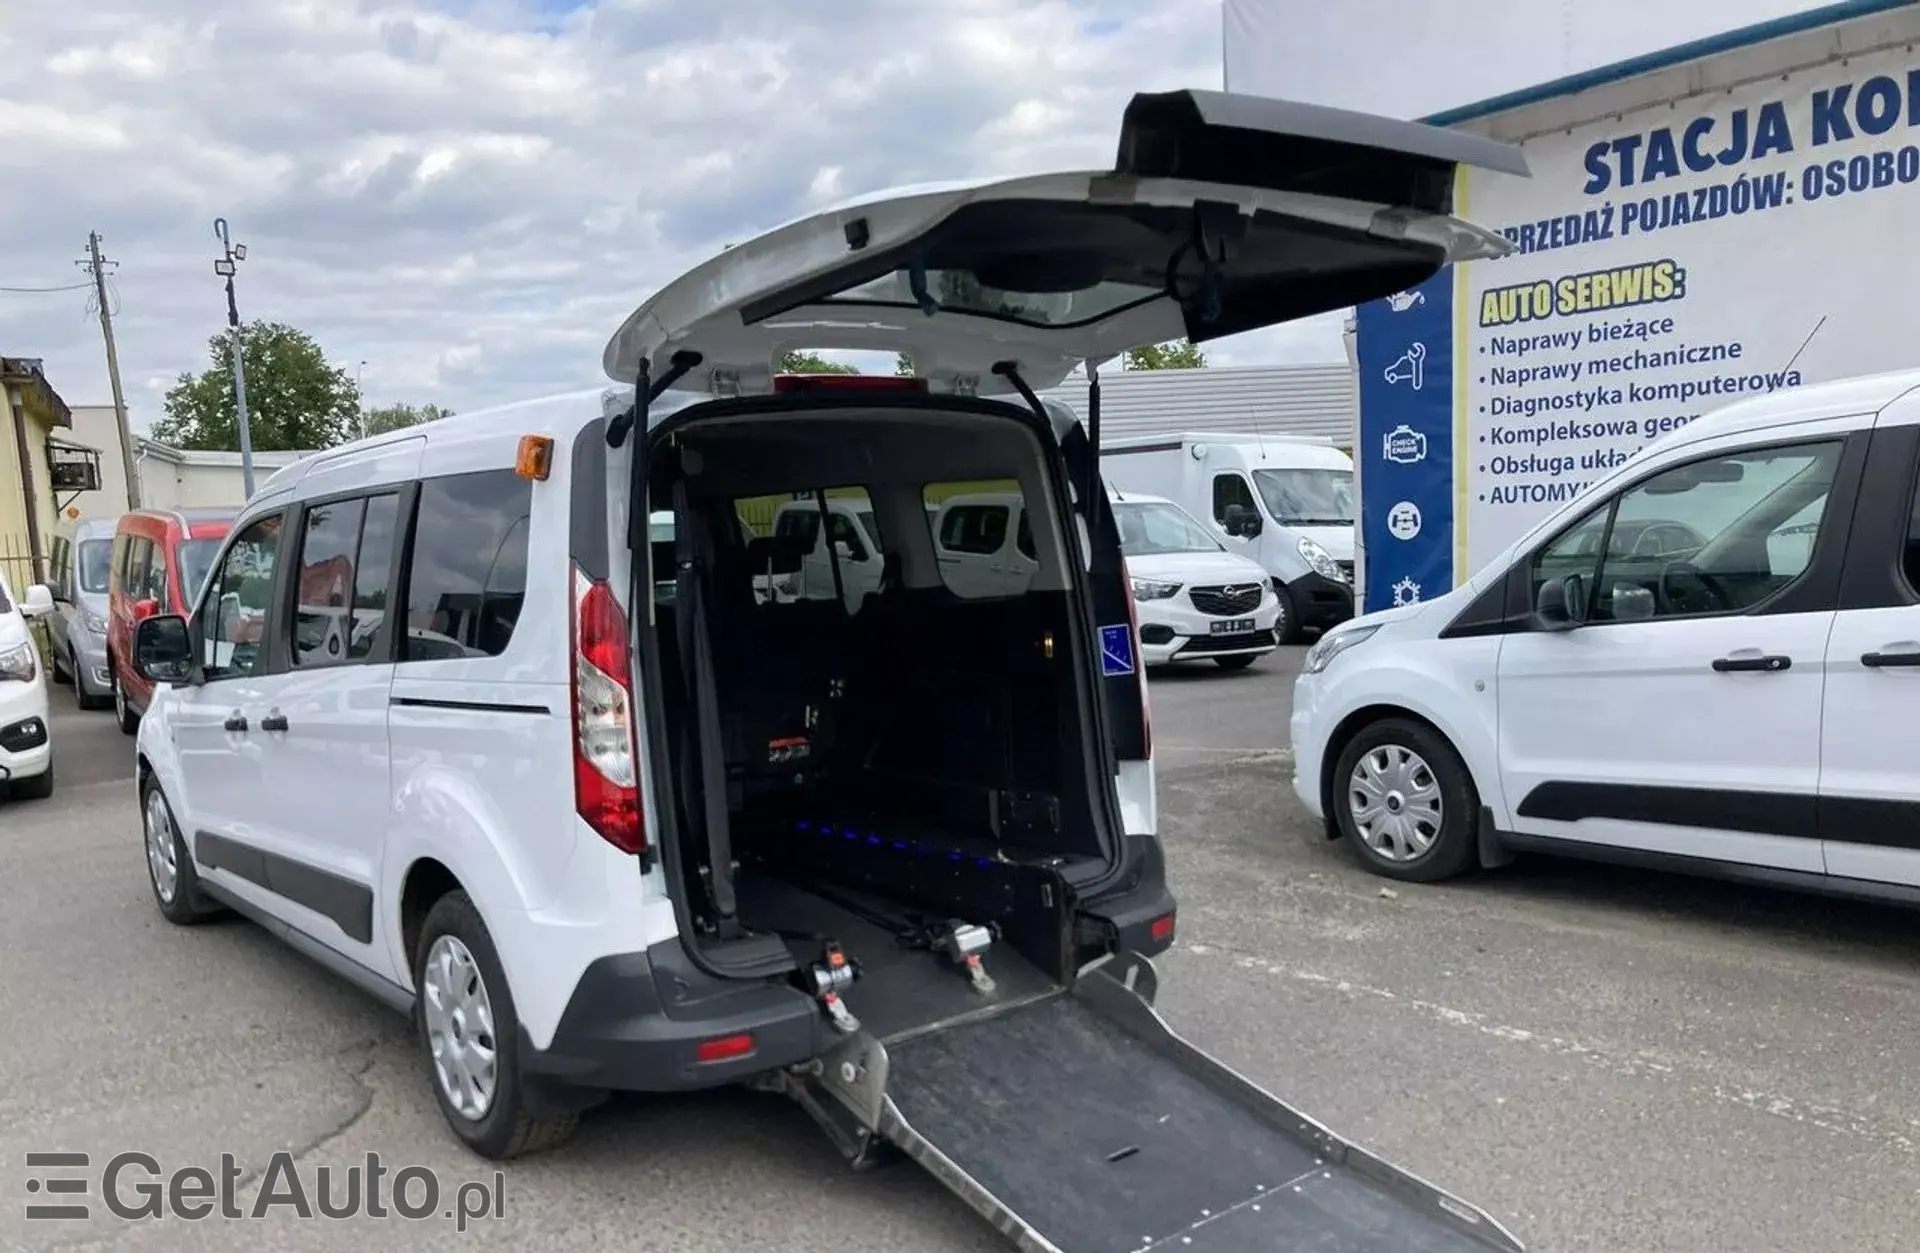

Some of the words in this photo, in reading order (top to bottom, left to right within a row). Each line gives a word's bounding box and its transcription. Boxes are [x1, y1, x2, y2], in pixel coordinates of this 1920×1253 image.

[1583, 100, 1794, 195] STACJA
[1812, 69, 1920, 146] KO
[1621, 173, 1794, 236] POJAZDÓW:
[1802, 146, 1920, 201] OSOBO
[1480, 279, 1553, 327] AUTO
[1555, 258, 1686, 316] SERWIS:
[1491, 330, 1582, 356] Naprawy
[1588, 317, 1674, 343] bieżące
[1491, 361, 1582, 387] Naprawy
[1588, 342, 1742, 375] mechaniczne
[1491, 386, 1622, 417] Diagnostyka
[1629, 370, 1801, 403] komputerowa
[1491, 420, 1637, 446] Kompleksowa
[1644, 414, 1700, 438] geo
[1491, 454, 1575, 476] Obsługa
[1581, 446, 1643, 469] ukła
